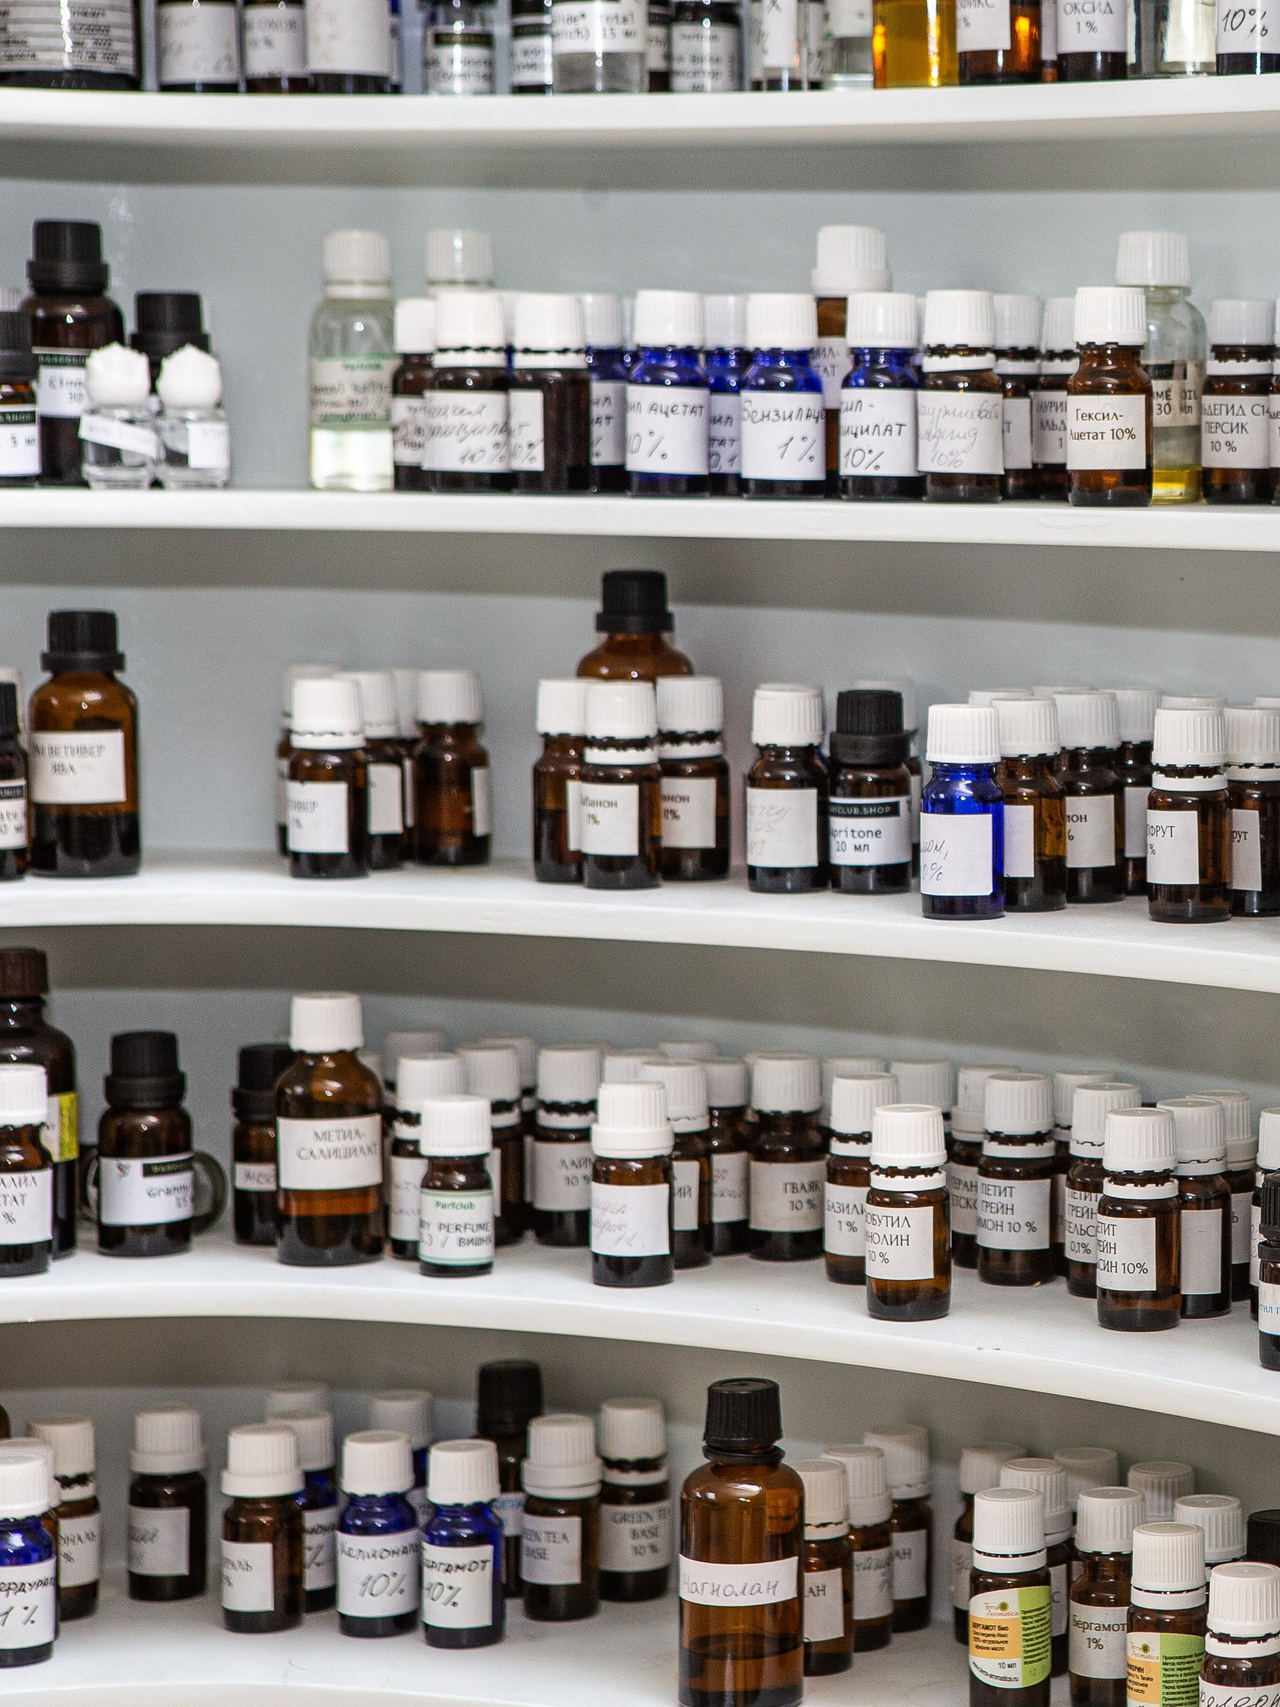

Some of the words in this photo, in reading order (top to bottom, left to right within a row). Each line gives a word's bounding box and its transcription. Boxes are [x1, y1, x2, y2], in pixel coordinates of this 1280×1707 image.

[1063, 2, 1115, 16] ОКСИД
[1221, 8, 1269, 37] 10%
[1075, 409, 1124, 422] Гексил-
[1069, 429, 1107, 442] Ацетат
[1111, 428, 1137, 441] 10%
[1204, 421, 1249, 435] ПЕРСИК
[778, 435, 818, 463] 1%
[1210, 441, 1222, 453] 10
[1225, 441, 1238, 453] %
[843, 448, 886, 472] 10%
[435, 1200, 476, 1211] Parfclub
[438, 1221, 492, 1235] PERFUME
[1007, 1221, 1022, 1233] 10
[1025, 1220, 1037, 1233] %
[1121, 1261, 1149, 1275] 10%
[359, 1571, 408, 1598] 10%
[1073, 1613, 1128, 1633] Бергамот
[1086, 1636, 1104, 1651] 1%
